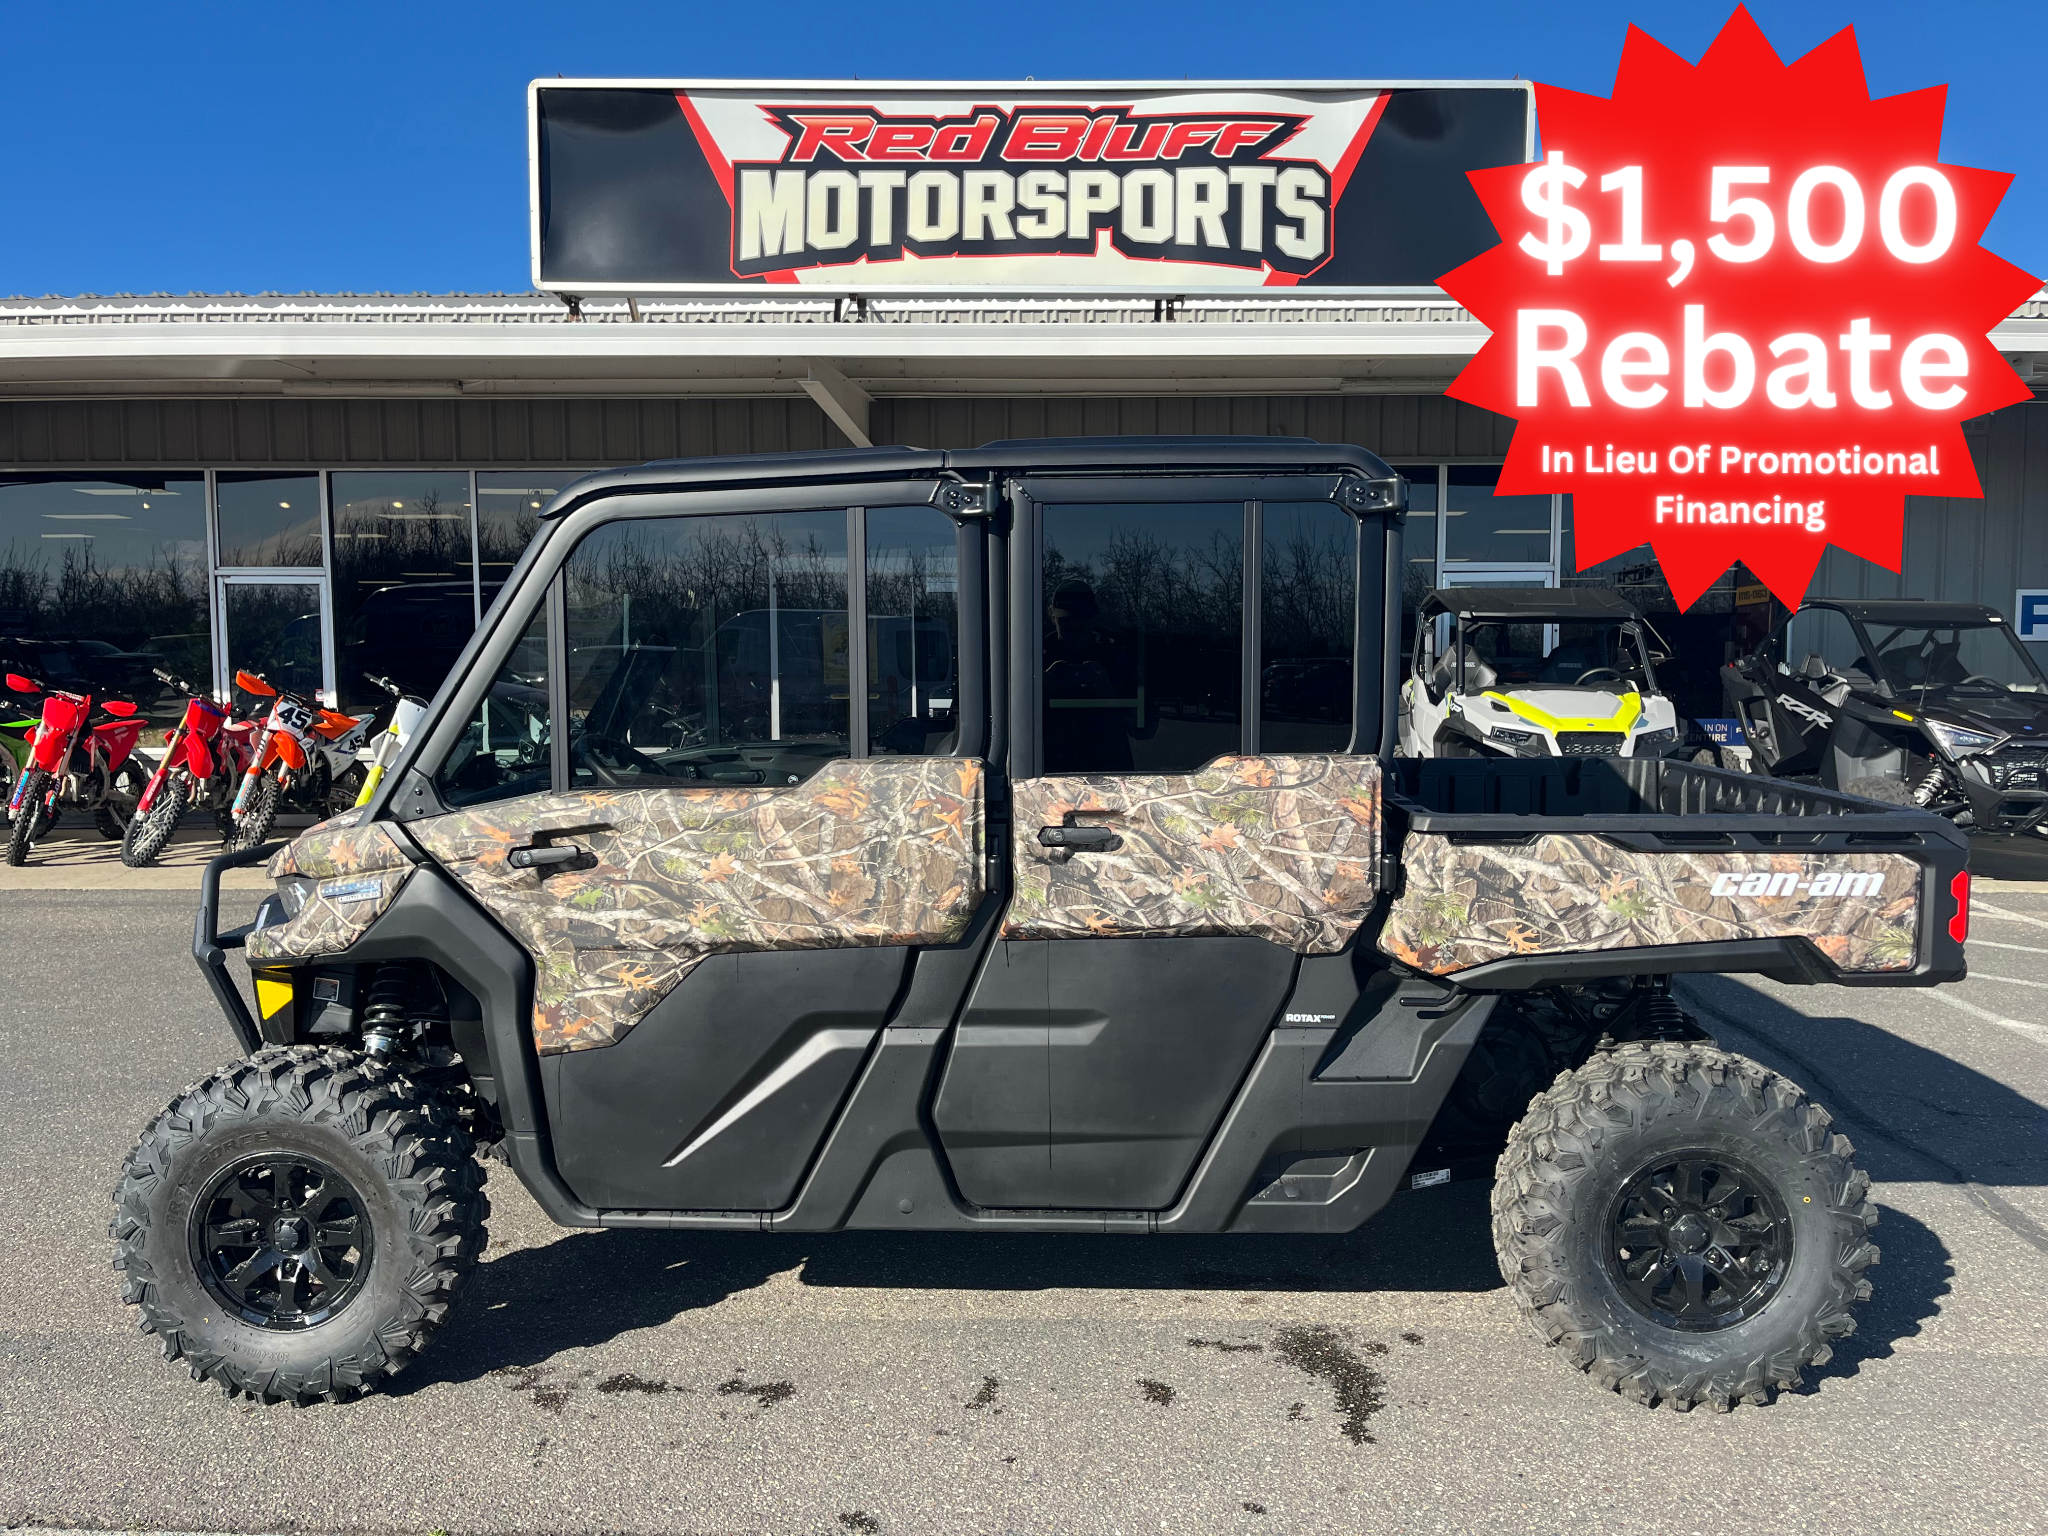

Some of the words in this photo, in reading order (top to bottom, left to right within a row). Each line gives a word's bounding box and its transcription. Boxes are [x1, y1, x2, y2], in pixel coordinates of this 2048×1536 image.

[791, 115, 989, 162] Red
[739, 167, 1326, 261] MOTORSPORTS
[278, 706, 312, 730] 45
[1775, 693, 1834, 729] RZR
[1715, 723, 1728, 732] ON
[349, 734, 364, 751] 45
[1709, 872, 1886, 897] can-am
[1285, 1013, 1321, 1023] ROTAX
